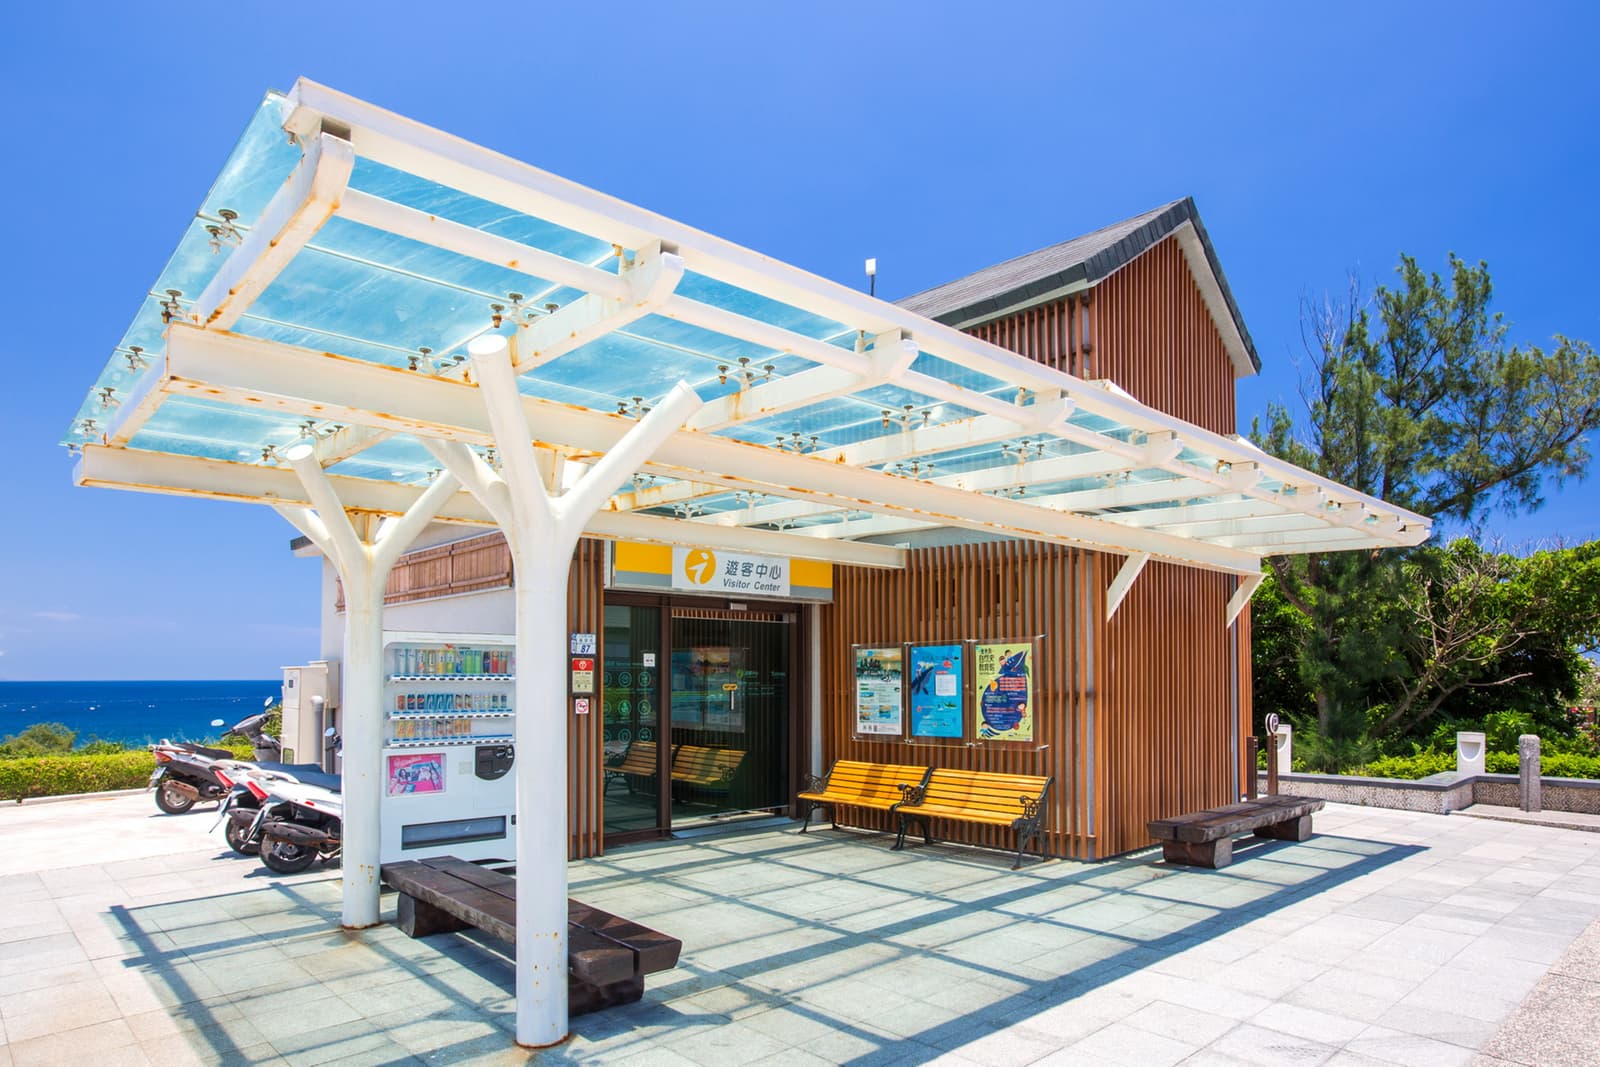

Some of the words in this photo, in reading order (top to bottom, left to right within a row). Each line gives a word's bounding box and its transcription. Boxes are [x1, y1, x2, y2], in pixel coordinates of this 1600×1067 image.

[725, 560, 781, 580] 遊客中心
[723, 578, 751, 589] Visitor
[754, 581, 781, 592] Center
[580, 644, 591, 654] 87
